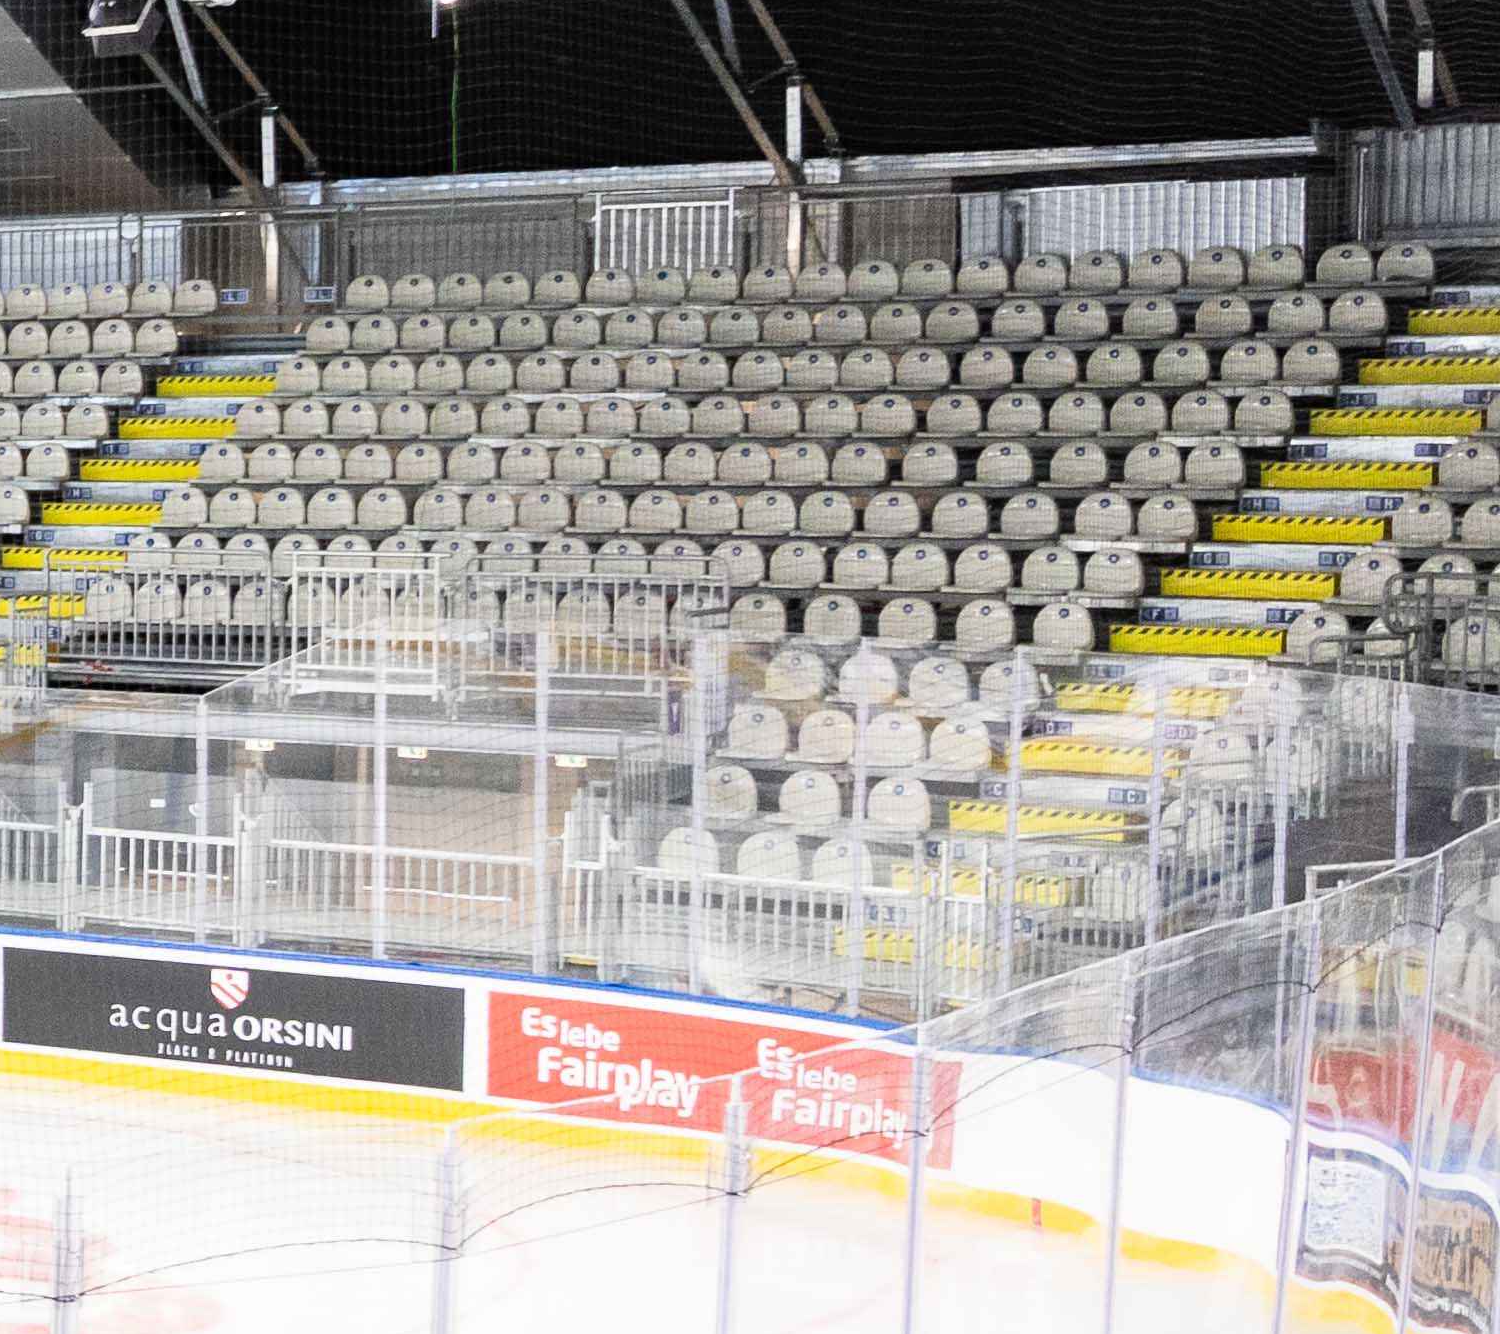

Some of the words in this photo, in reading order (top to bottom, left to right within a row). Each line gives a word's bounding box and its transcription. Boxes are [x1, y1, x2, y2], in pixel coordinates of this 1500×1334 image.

[521, 1006, 557, 1038] Es
[560, 1019, 620, 1051] lebe
[537, 1047, 700, 1117] Fairplay
[796, 1063, 858, 1093] lebe
[771, 1089, 908, 1149] Fairplay
